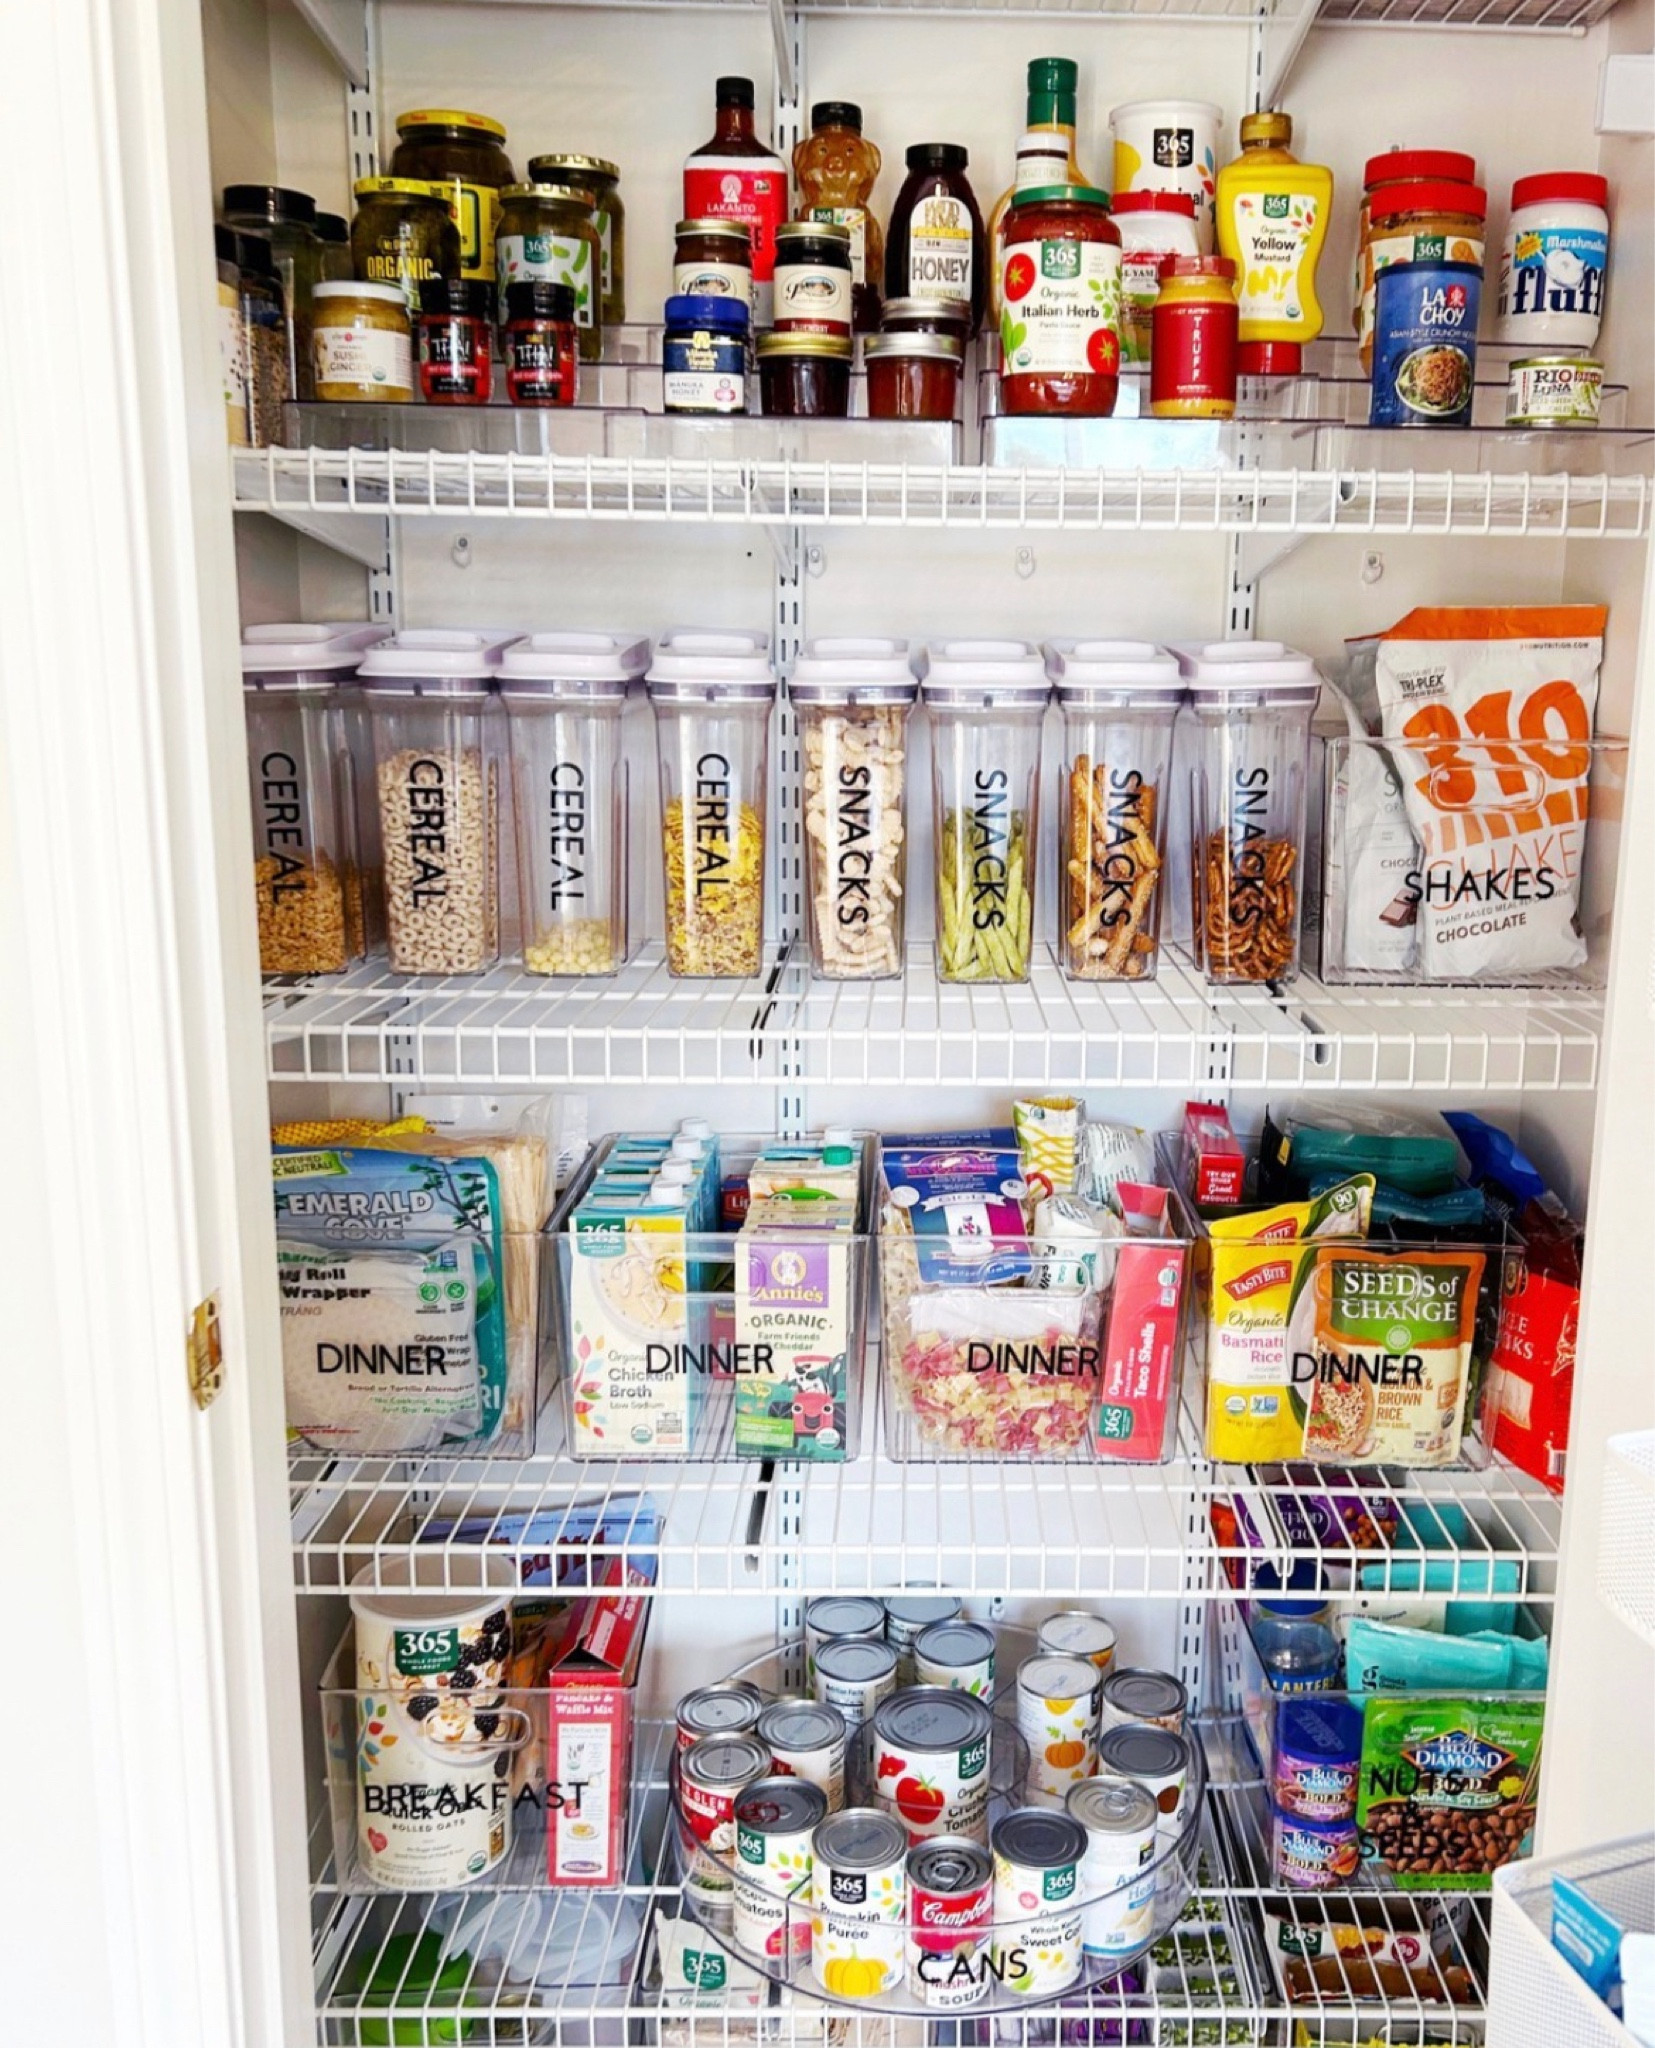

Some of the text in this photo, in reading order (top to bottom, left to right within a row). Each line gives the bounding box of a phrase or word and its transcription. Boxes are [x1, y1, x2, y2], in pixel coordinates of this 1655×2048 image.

[1157, 134, 1191, 154] 365
[706, 203, 756, 213] LAKANTO
[1266, 198, 1288, 208] 365
[526, 241, 549, 255] 365
[1251, 237, 1297, 250] Yellow
[1416, 241, 1443, 257] 365
[1045, 247, 1077, 267] 365
[1254, 252, 1291, 262] Mustard
[367, 256, 434, 279] ORGANIC
[911, 256, 970, 282] HONEY
[1040, 286, 1079, 300] Organic
[1422, 286, 1446, 307] LA
[1021, 304, 1100, 318] Italian Herb
[1420, 307, 1466, 326] CHOY
[1190, 316, 1203, 381] TRUFF
[1534, 368, 1572, 383] RIO
[1402, 679, 1592, 808] 310
[261, 752, 306, 904] CEREAL
[408, 759, 446, 909] CEREAL
[696, 753, 730, 896] CEREAL
[549, 761, 585, 911] CEREAL
[838, 766, 872, 925] SNACKS
[1231, 767, 1269, 923] SNACKS
[972, 769, 1008, 930] SNACKS
[1100, 769, 1143, 927] SNACKS
[1404, 867, 1557, 903] SHAKES
[1436, 912, 1527, 944] CHOCOLATE
[287, 1190, 434, 1216] EMERALD
[1336, 1191, 1353, 1205] 90
[324, 1214, 405, 1241] COVE
[306, 1268, 346, 1280] Roll
[1231, 1265, 1287, 1296] TASTY BITE
[1344, 1270, 1459, 1298] SEEDS of
[282, 1286, 371, 1301] Wrapper
[752, 1285, 824, 1304] Annie's
[1341, 1298, 1458, 1322] CHANGE
[750, 1313, 828, 1331] ORGANIC
[1228, 1310, 1284, 1334] Organic
[758, 1331, 821, 1341] Farm Friends
[1221, 1333, 1284, 1348] Basmati
[316, 1343, 447, 1376] DINNER
[646, 1343, 775, 1375] DINNER
[967, 1342, 1100, 1377] DINNER
[1133, 1321, 1156, 1399] Taco Shells
[1250, 1350, 1284, 1363] Rice
[1291, 1352, 1424, 1386] DINNER
[609, 1384, 652, 1398] Broth
[1426, 1377, 1434, 1391] &
[609, 1401, 629, 1410] Low
[1378, 1391, 1423, 1406] BROWN
[1104, 1408, 1123, 1438] 365
[1376, 1406, 1404, 1420] RICE
[400, 1630, 452, 1657] 365
[555, 1704, 615, 1715] Waffle Mix
[1440, 1742, 1481, 1756] BLUE
[1415, 1750, 1503, 1769] DIAMOND
[1296, 1773, 1353, 1790] DIAMOND
[1311, 1767, 1339, 1780] BLUE
[1369, 1766, 1464, 1796] NUTS
[364, 1781, 590, 1813] BREAKFAST
[694, 1789, 727, 1811] GLEN
[1305, 1794, 1342, 1804] BOLD
[1402, 1800, 1424, 1827] &
[391, 1818, 466, 1833] ROLLED OATS
[1358, 1831, 1465, 1858] SEEDS
[1287, 1855, 1322, 1870] BOLD
[833, 1876, 864, 1895] 365
[1046, 1869, 1074, 1892] 365
[737, 1895, 783, 1918] matoes
[1030, 1924, 1059, 1935] Whole
[1020, 1934, 1062, 1947] Sweet
[686, 1956, 722, 1974] 365
[917, 1948, 1028, 1984] CANS
[938, 1986, 984, 2005] SOUP
